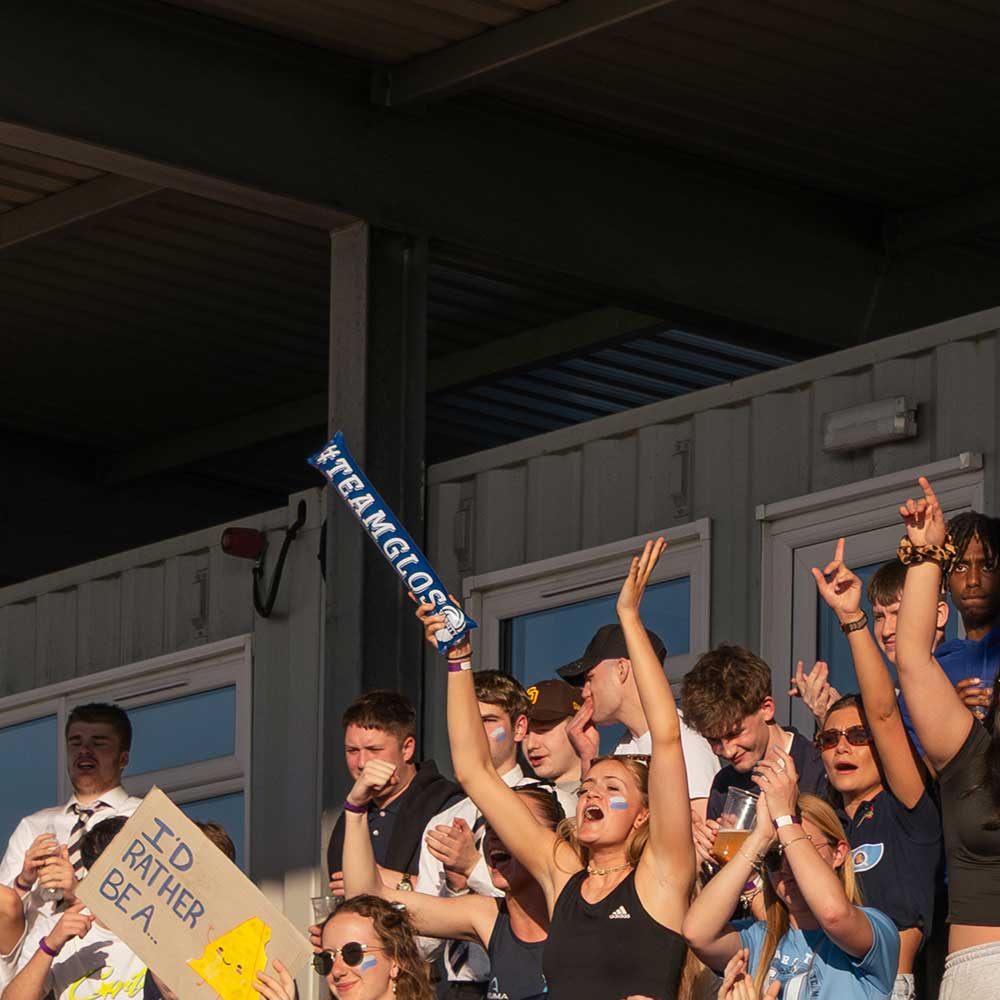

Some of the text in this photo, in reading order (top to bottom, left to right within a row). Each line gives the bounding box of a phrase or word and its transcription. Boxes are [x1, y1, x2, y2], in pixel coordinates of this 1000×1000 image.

[317, 444, 447, 608] #TEAMGLOS
[141, 816, 194, 872] I'D
[99, 867, 142, 914] BE
[121, 838, 205, 930] RATHER
